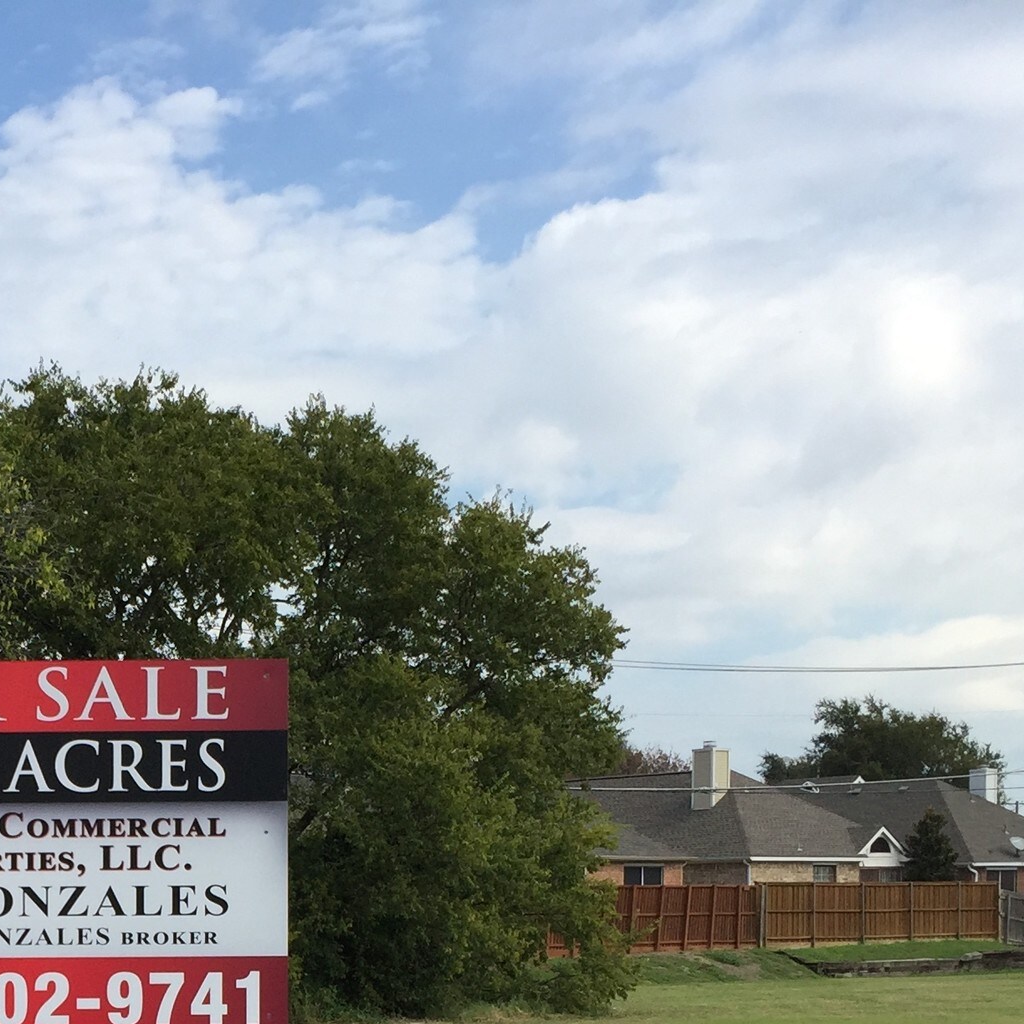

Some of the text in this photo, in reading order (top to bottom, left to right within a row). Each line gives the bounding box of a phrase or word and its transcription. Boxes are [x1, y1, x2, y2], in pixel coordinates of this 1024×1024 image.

[36, 665, 229, 721] SALE
[2, 738, 226, 793] ACRES
[99, 844, 192, 871] LLC.
[121, 931, 218, 945] BROKER
